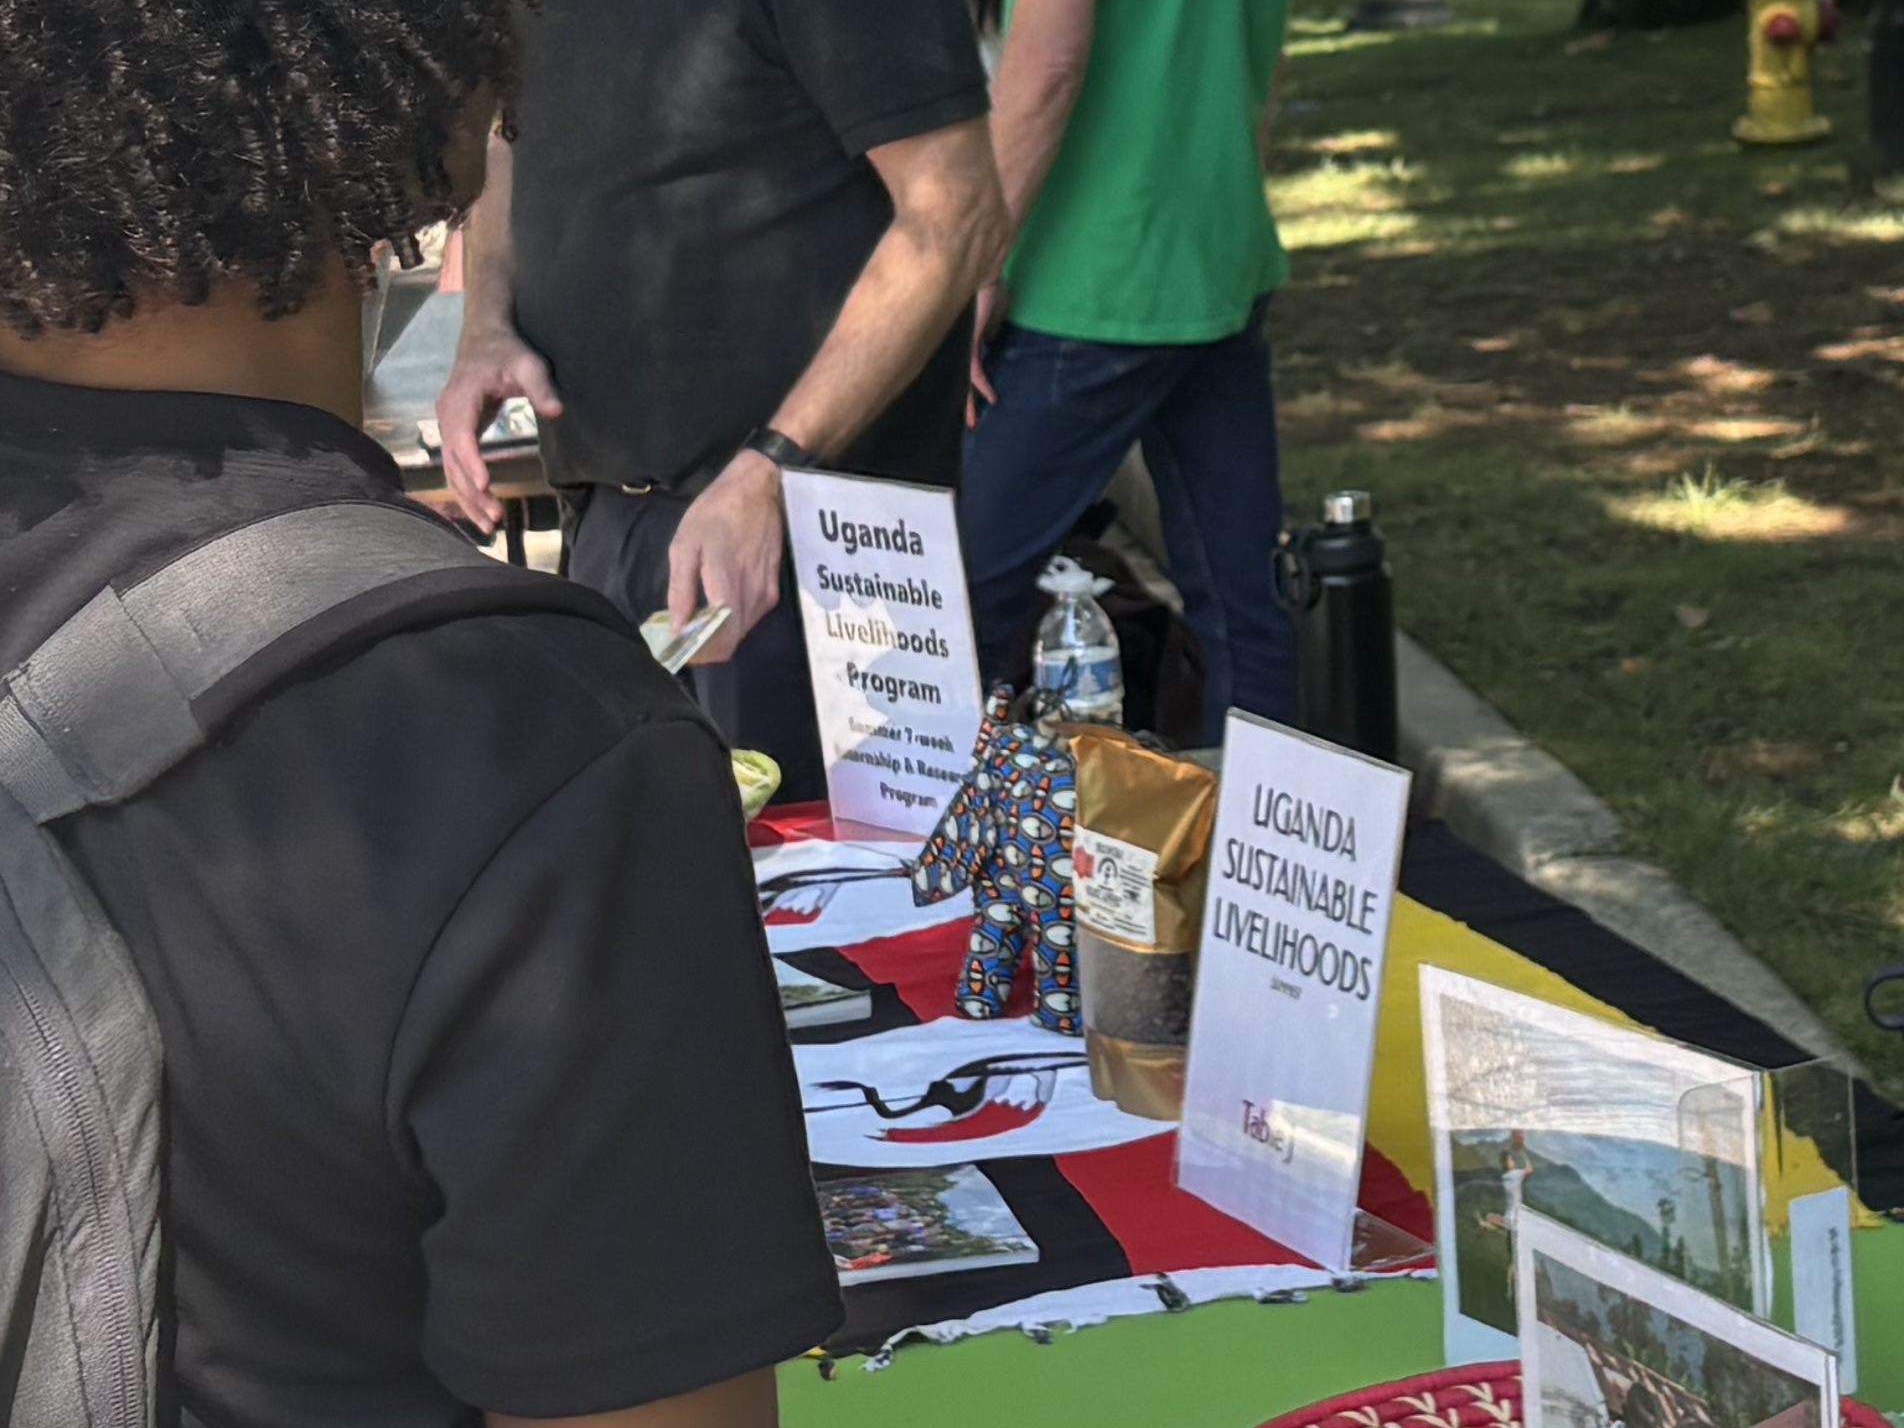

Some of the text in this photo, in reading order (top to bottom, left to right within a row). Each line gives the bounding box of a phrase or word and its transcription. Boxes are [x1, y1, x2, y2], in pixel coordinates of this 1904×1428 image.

[819, 509, 924, 556] Uganda
[817, 564, 943, 610] Sustainable
[827, 611, 949, 659] Livelihoods
[846, 662, 941, 705] Program
[1253, 783, 1356, 862] UGANDA
[1223, 837, 1378, 935] SUSTAINABLE
[1213, 896, 1372, 1001] LIVELIHOODS
